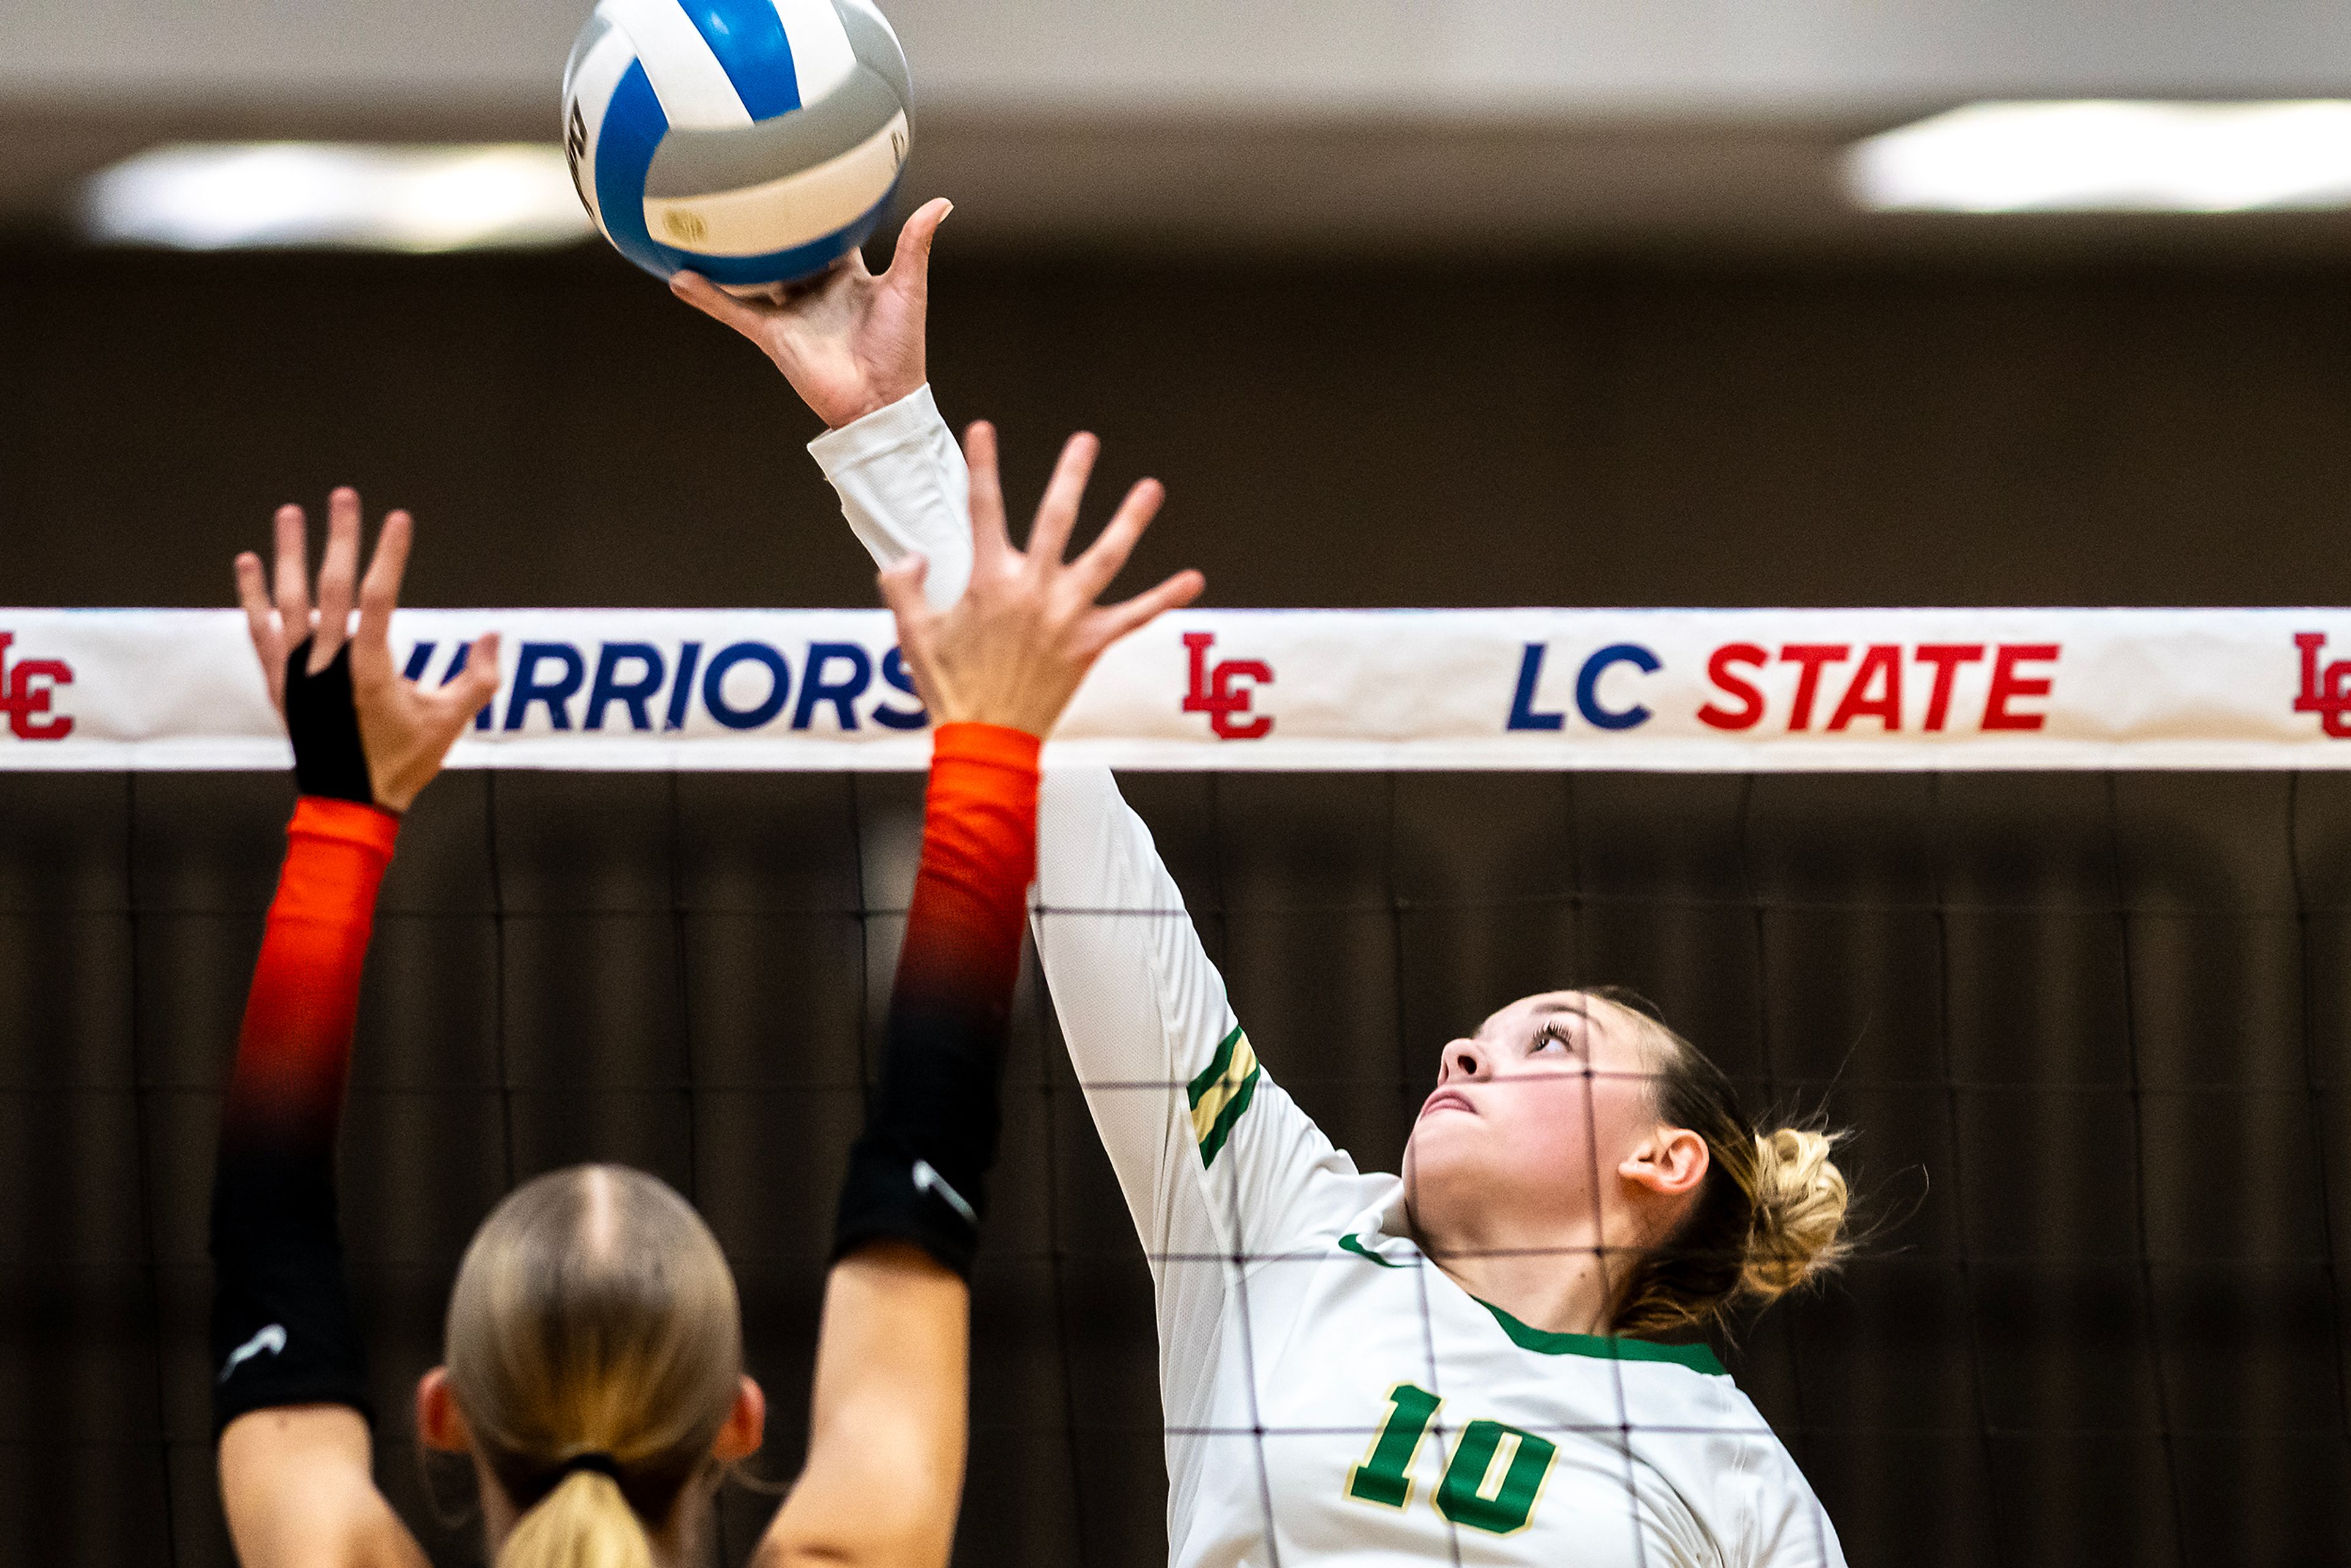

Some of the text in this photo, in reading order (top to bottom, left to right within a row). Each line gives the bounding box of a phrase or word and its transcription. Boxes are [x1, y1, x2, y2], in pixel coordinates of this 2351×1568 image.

[403, 640, 930, 731] RRIORS
[1182, 631, 1273, 740] LC
[1505, 642, 2061, 732] LC STATE
[1343, 1380, 1561, 1538] 10
